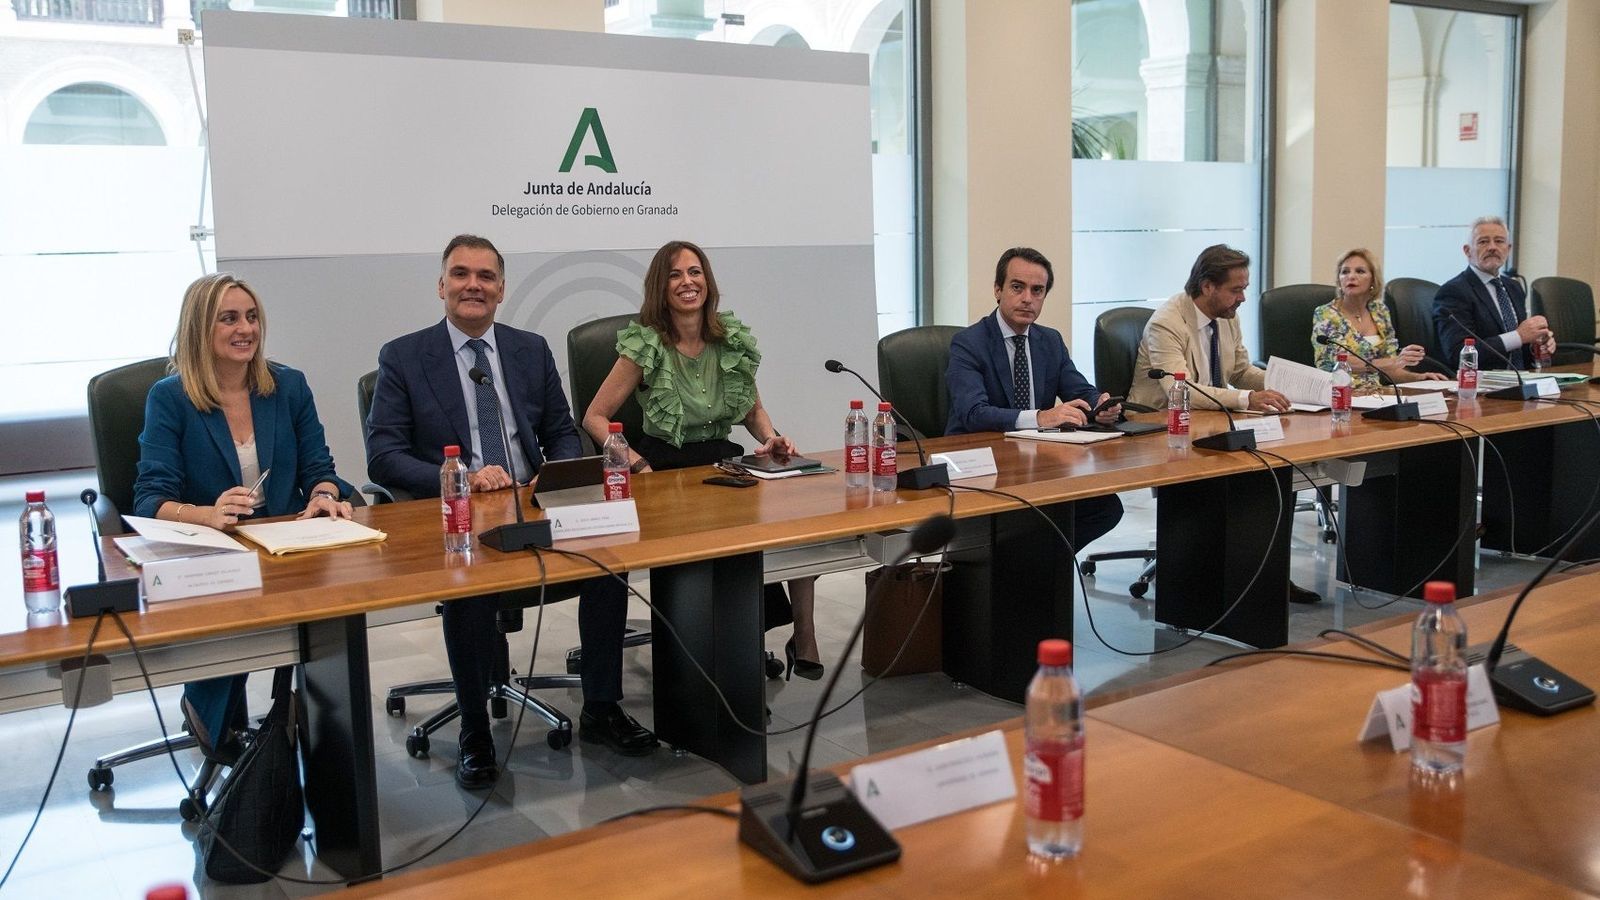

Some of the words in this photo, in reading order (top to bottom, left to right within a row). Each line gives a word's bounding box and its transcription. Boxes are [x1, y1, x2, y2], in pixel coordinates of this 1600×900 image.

[523, 181, 563, 195] Junta
[567, 181, 584, 195] de
[587, 181, 652, 195] Andalucía
[492, 203, 553, 218] Delegación
[555, 204, 568, 216] de
[571, 204, 620, 216] Gobierno
[622, 206, 634, 216] en
[637, 204, 679, 216] Granada
